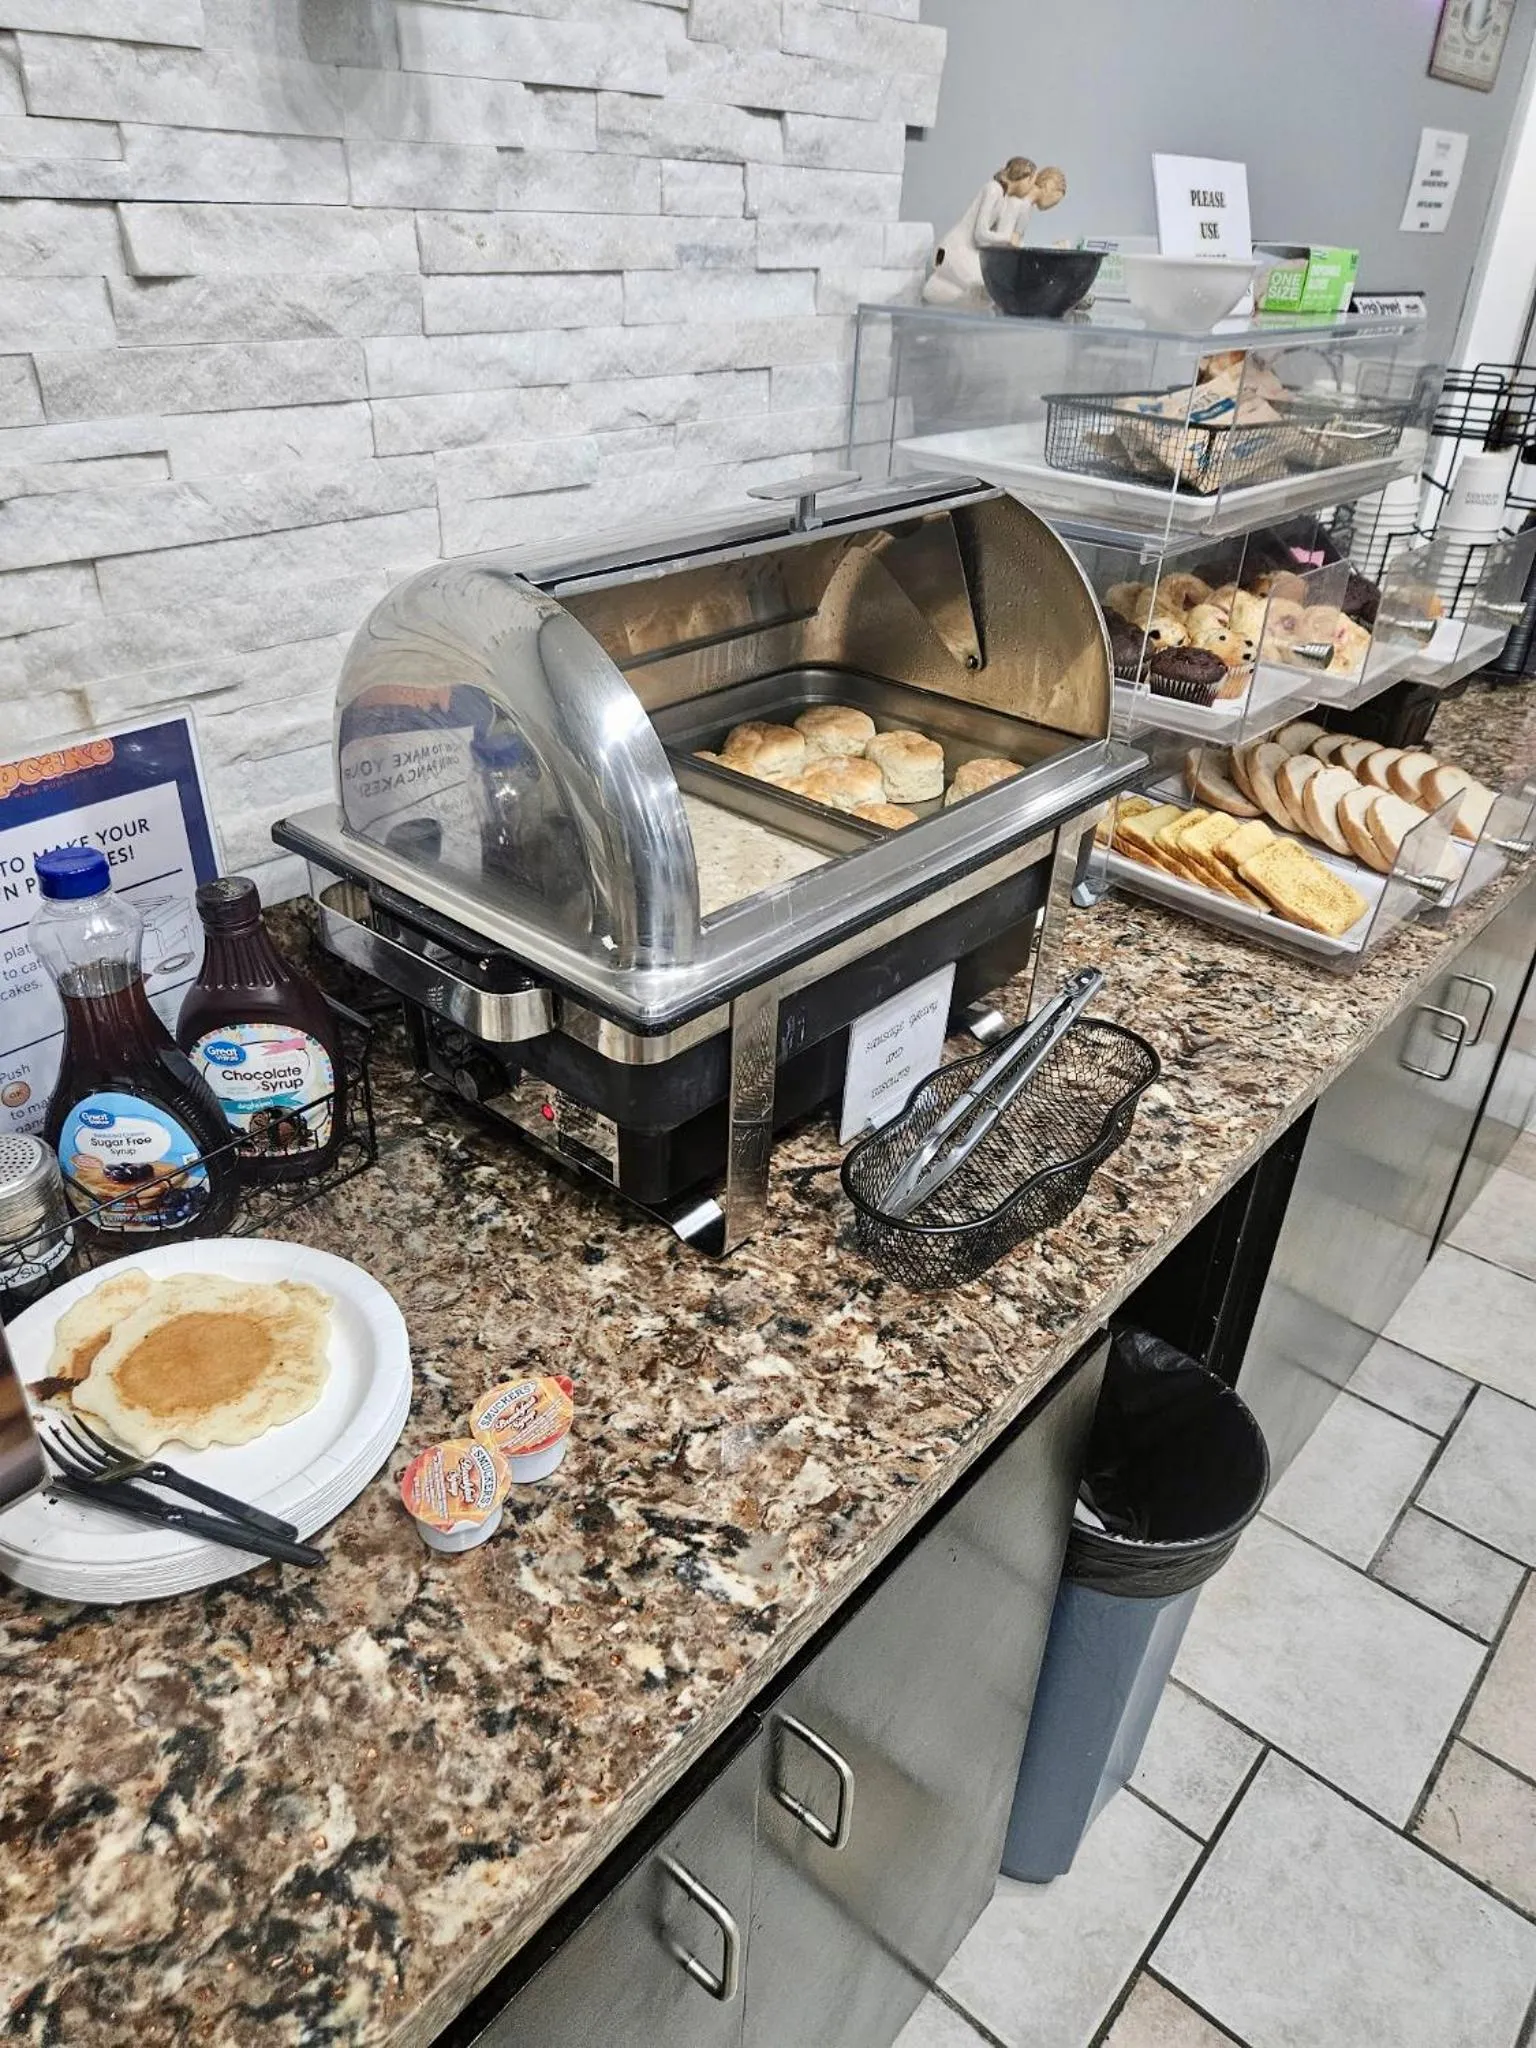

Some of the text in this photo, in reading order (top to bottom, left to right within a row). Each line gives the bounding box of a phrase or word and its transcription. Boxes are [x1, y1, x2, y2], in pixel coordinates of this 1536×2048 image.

[1190, 190, 1227, 208] PLEASE
[1200, 222, 1220, 240] USE
[1271, 272, 1301, 286] ONE
[1268, 286, 1298, 299] SIZE
[0, 857, 24, 877] TO
[96, 818, 150, 846] YOUR
[3, 969, 18, 982] to
[207, 1045, 237, 1057] Great
[222, 1065, 302, 1081] Chocolate
[261, 1077, 304, 1093] Syrup
[90, 1135, 153, 1149] Sugar Free
[110, 1147, 136, 1157] Syrup
